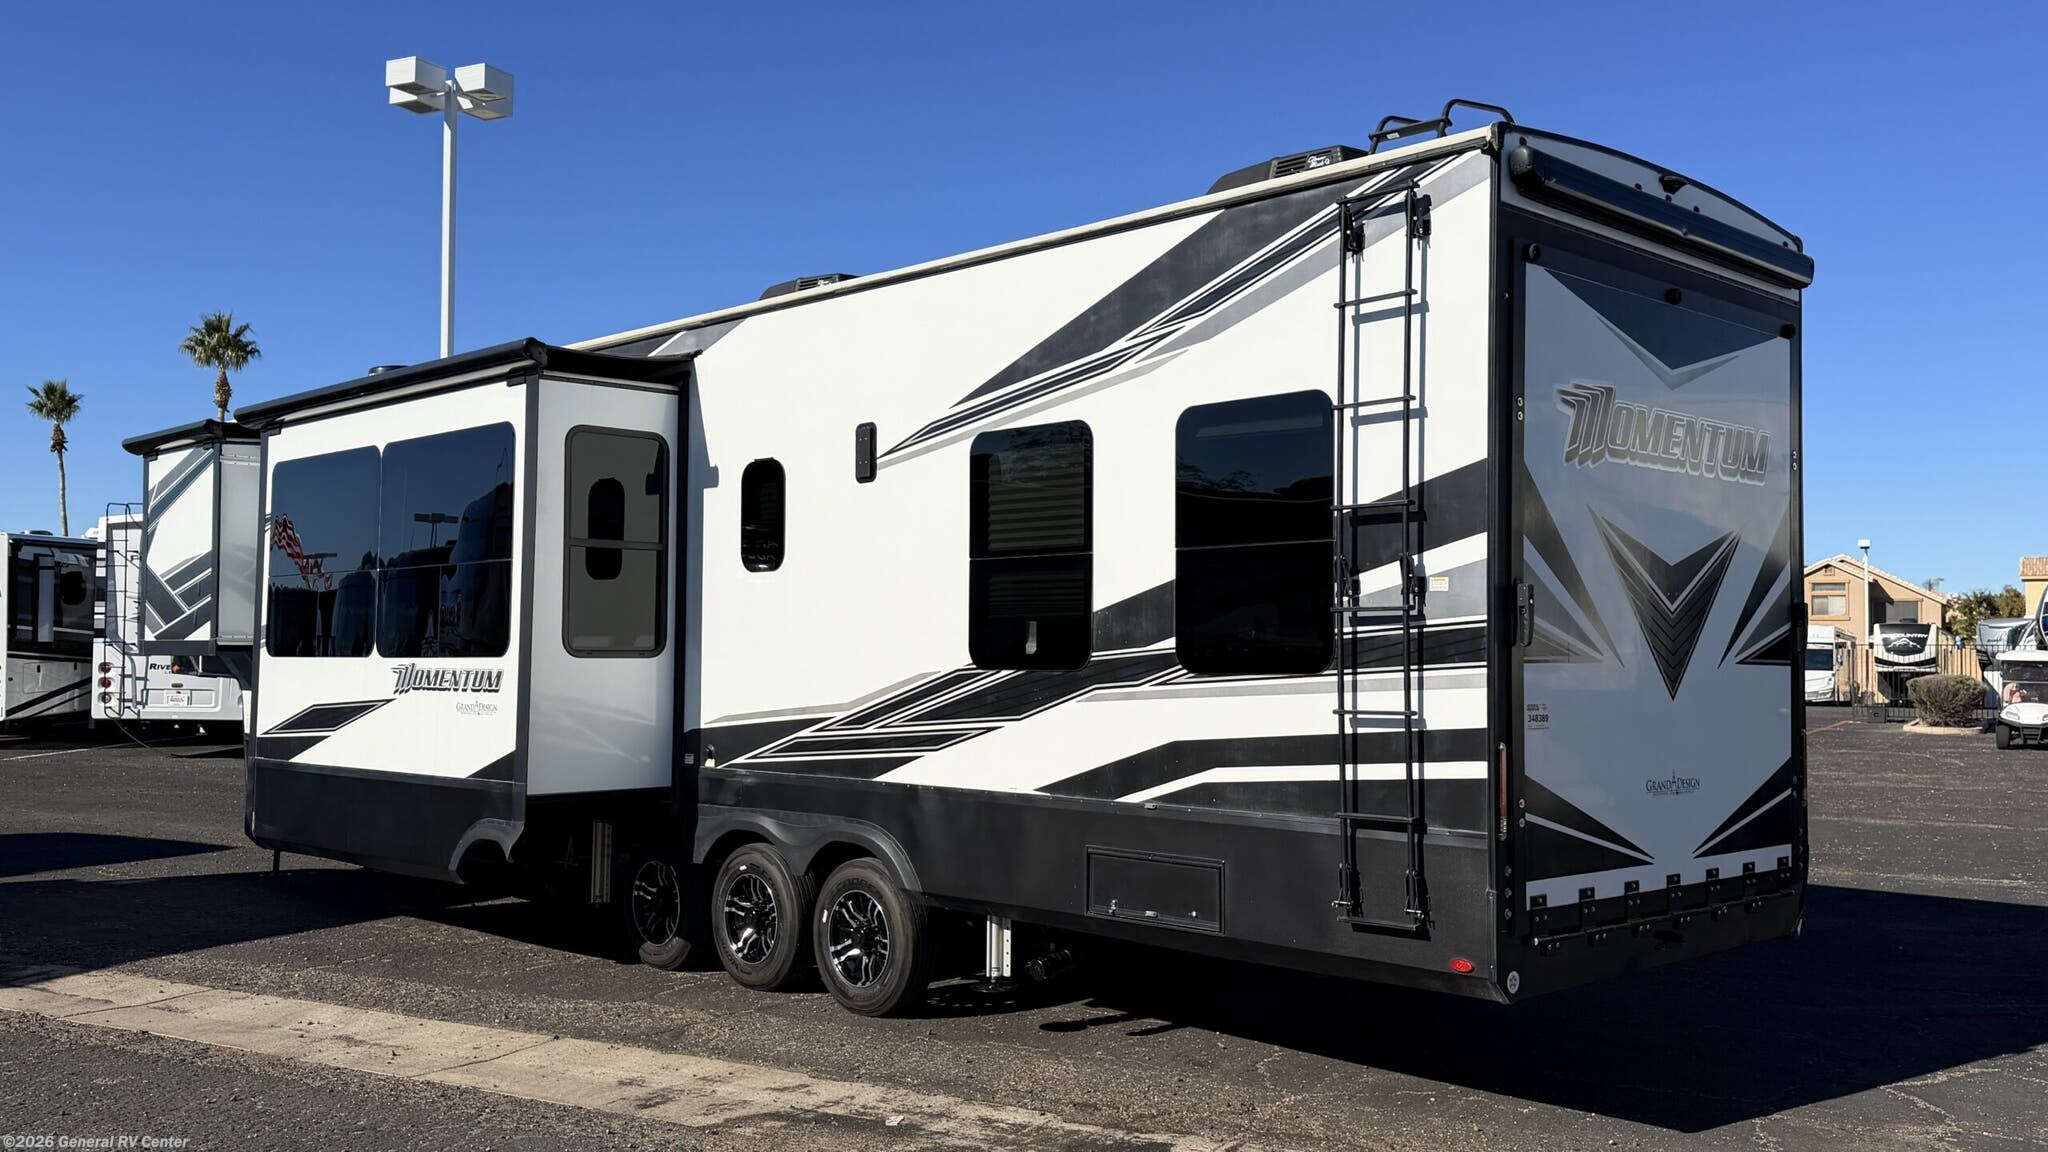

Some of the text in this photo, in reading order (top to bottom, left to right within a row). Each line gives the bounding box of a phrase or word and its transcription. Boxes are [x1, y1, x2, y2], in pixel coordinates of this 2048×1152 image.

[1555, 381, 1770, 487] MOMENTUM
[391, 662, 504, 695] MOMENTUM
[1645, 777, 1701, 792] GRAND DESIGN
